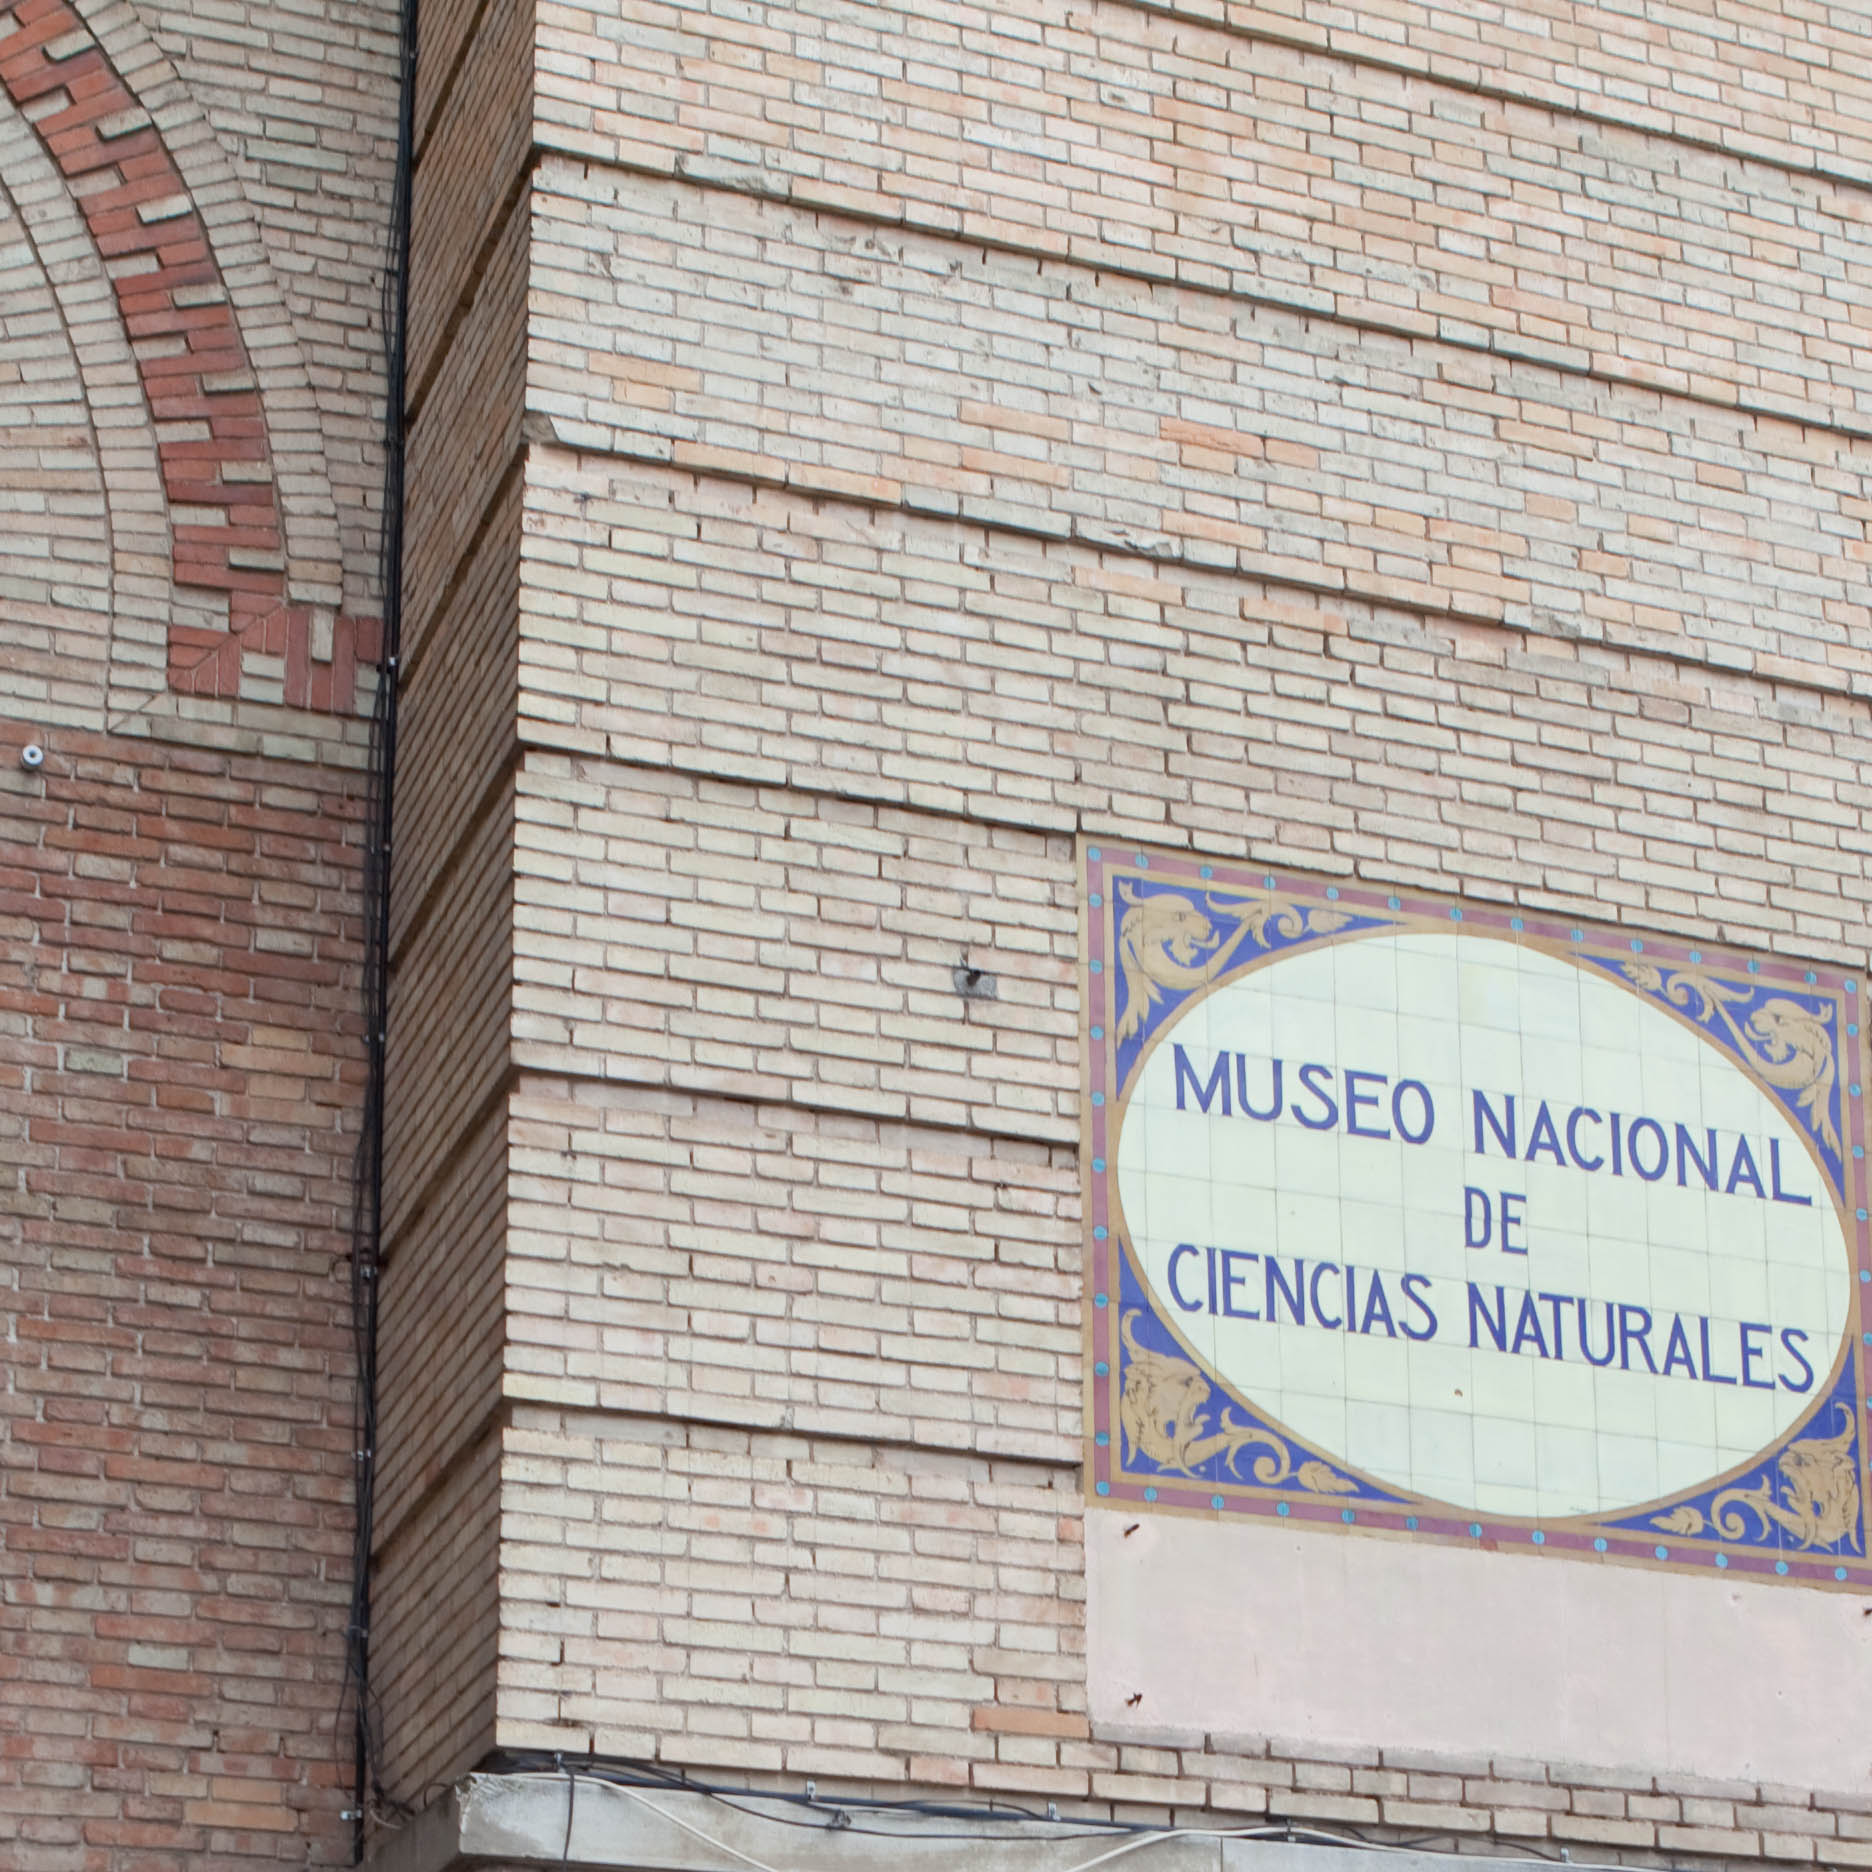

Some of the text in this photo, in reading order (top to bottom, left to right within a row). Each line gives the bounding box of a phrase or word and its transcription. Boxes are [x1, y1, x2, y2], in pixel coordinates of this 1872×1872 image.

[1171, 1043, 1813, 1207] MUSEO NACIONAL
[1463, 1186, 1529, 1256] DE
[1166, 1243, 1815, 1394] CIENCIAS NATURALES
